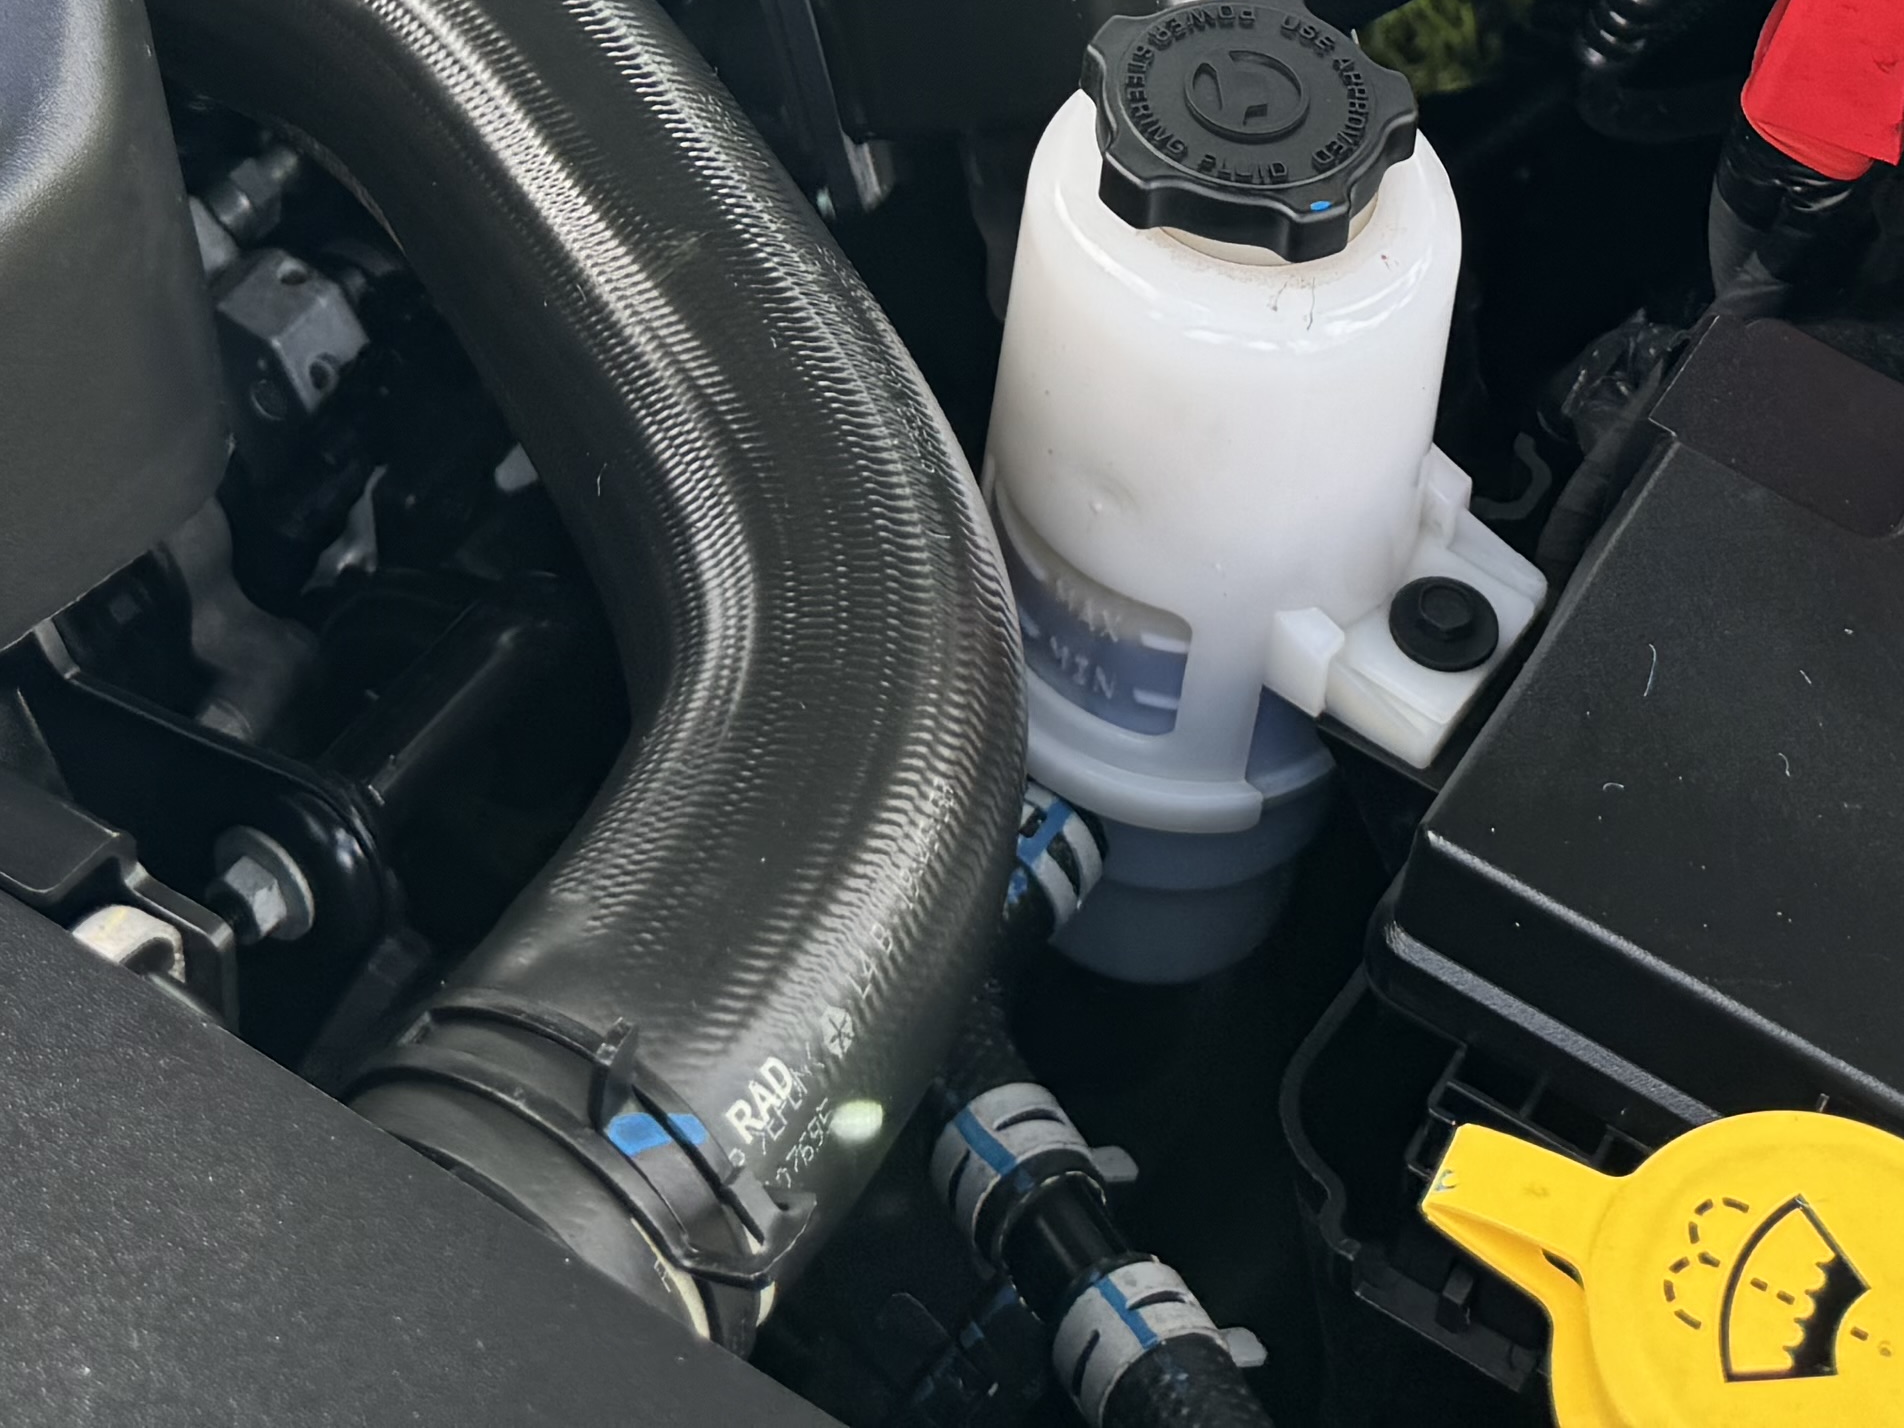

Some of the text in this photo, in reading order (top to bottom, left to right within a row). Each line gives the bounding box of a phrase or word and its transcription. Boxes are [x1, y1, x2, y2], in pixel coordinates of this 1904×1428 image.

[1147, 3, 1258, 46] POWER
[1125, 44, 1188, 161] STEERING
[1280, 14, 1370, 168] USE APPROVED
[1049, 634, 1118, 701] MIN
[724, 1055, 794, 1145] RAD
